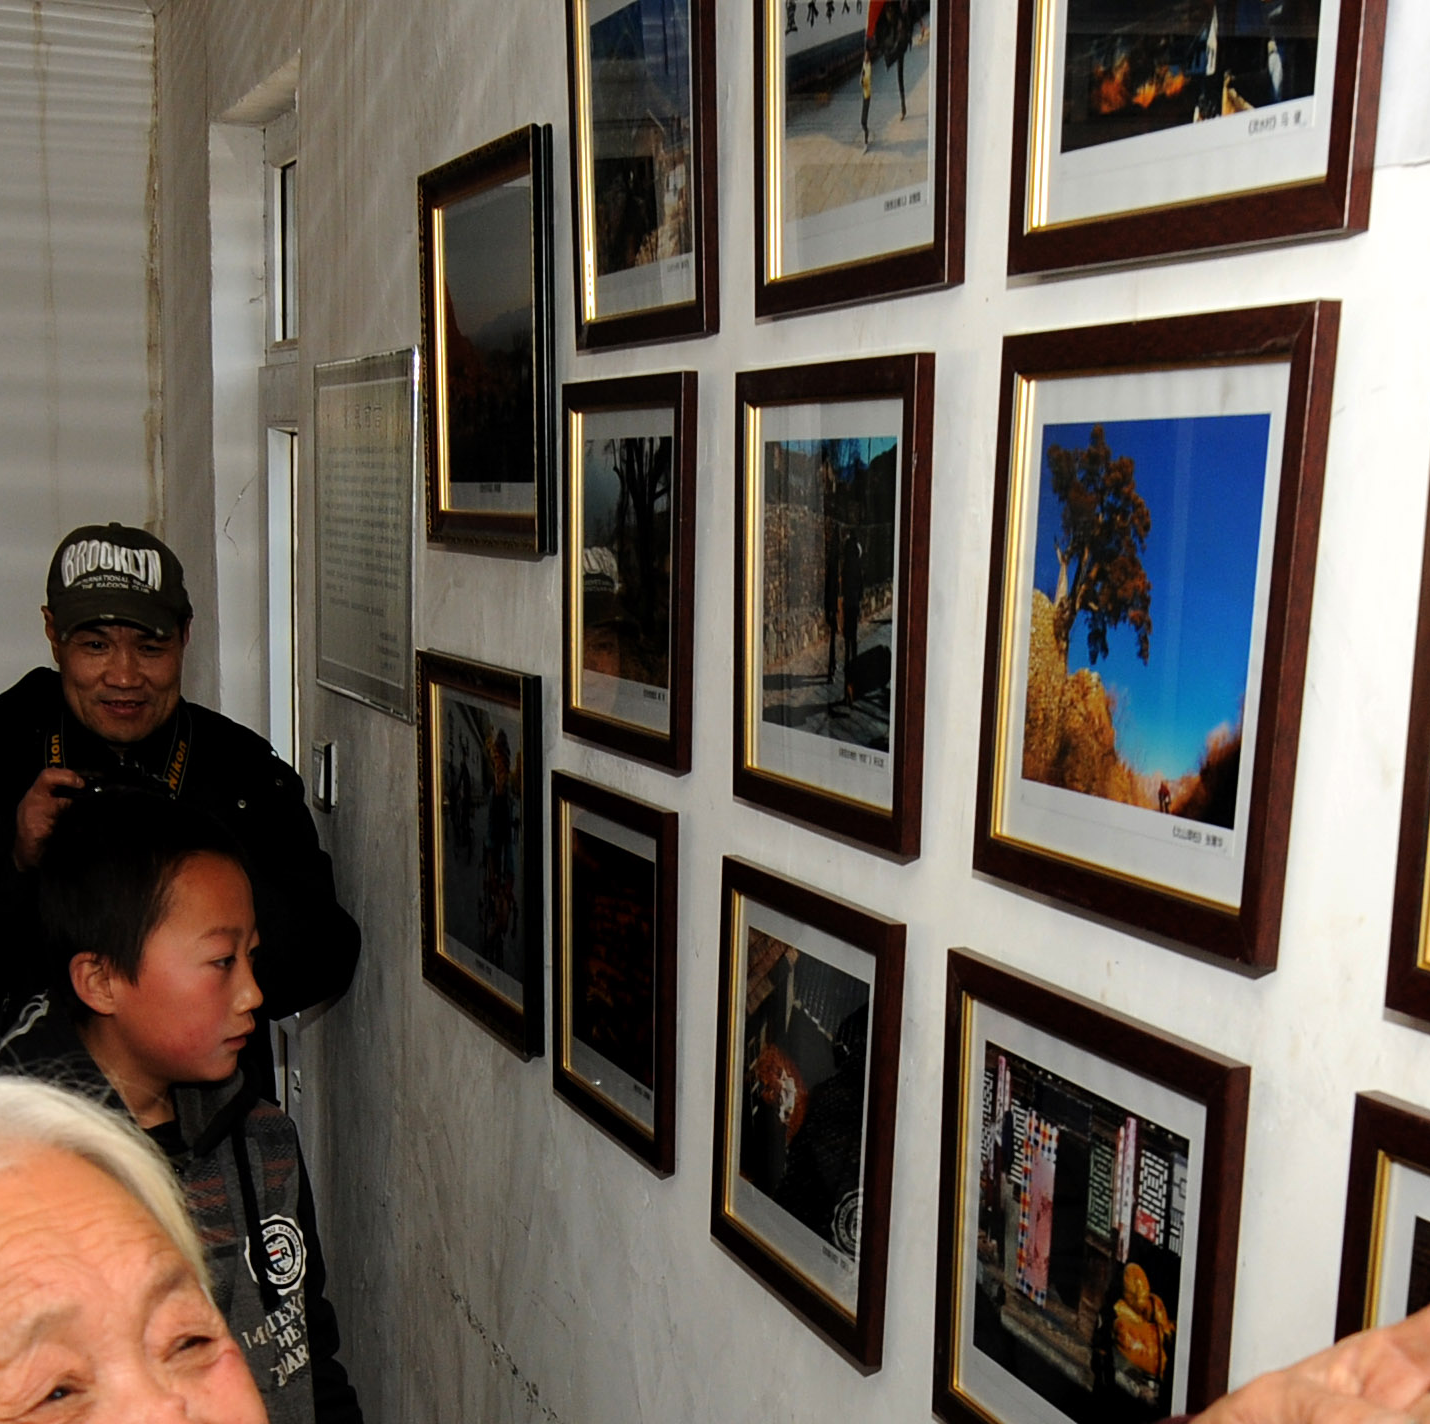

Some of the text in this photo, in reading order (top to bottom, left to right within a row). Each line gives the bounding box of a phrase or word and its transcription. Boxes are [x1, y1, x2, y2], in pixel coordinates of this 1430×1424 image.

[61, 539, 162, 592] BROOKLYN
[50, 734, 62, 764] kon
[168, 740, 187, 791] Nikon
